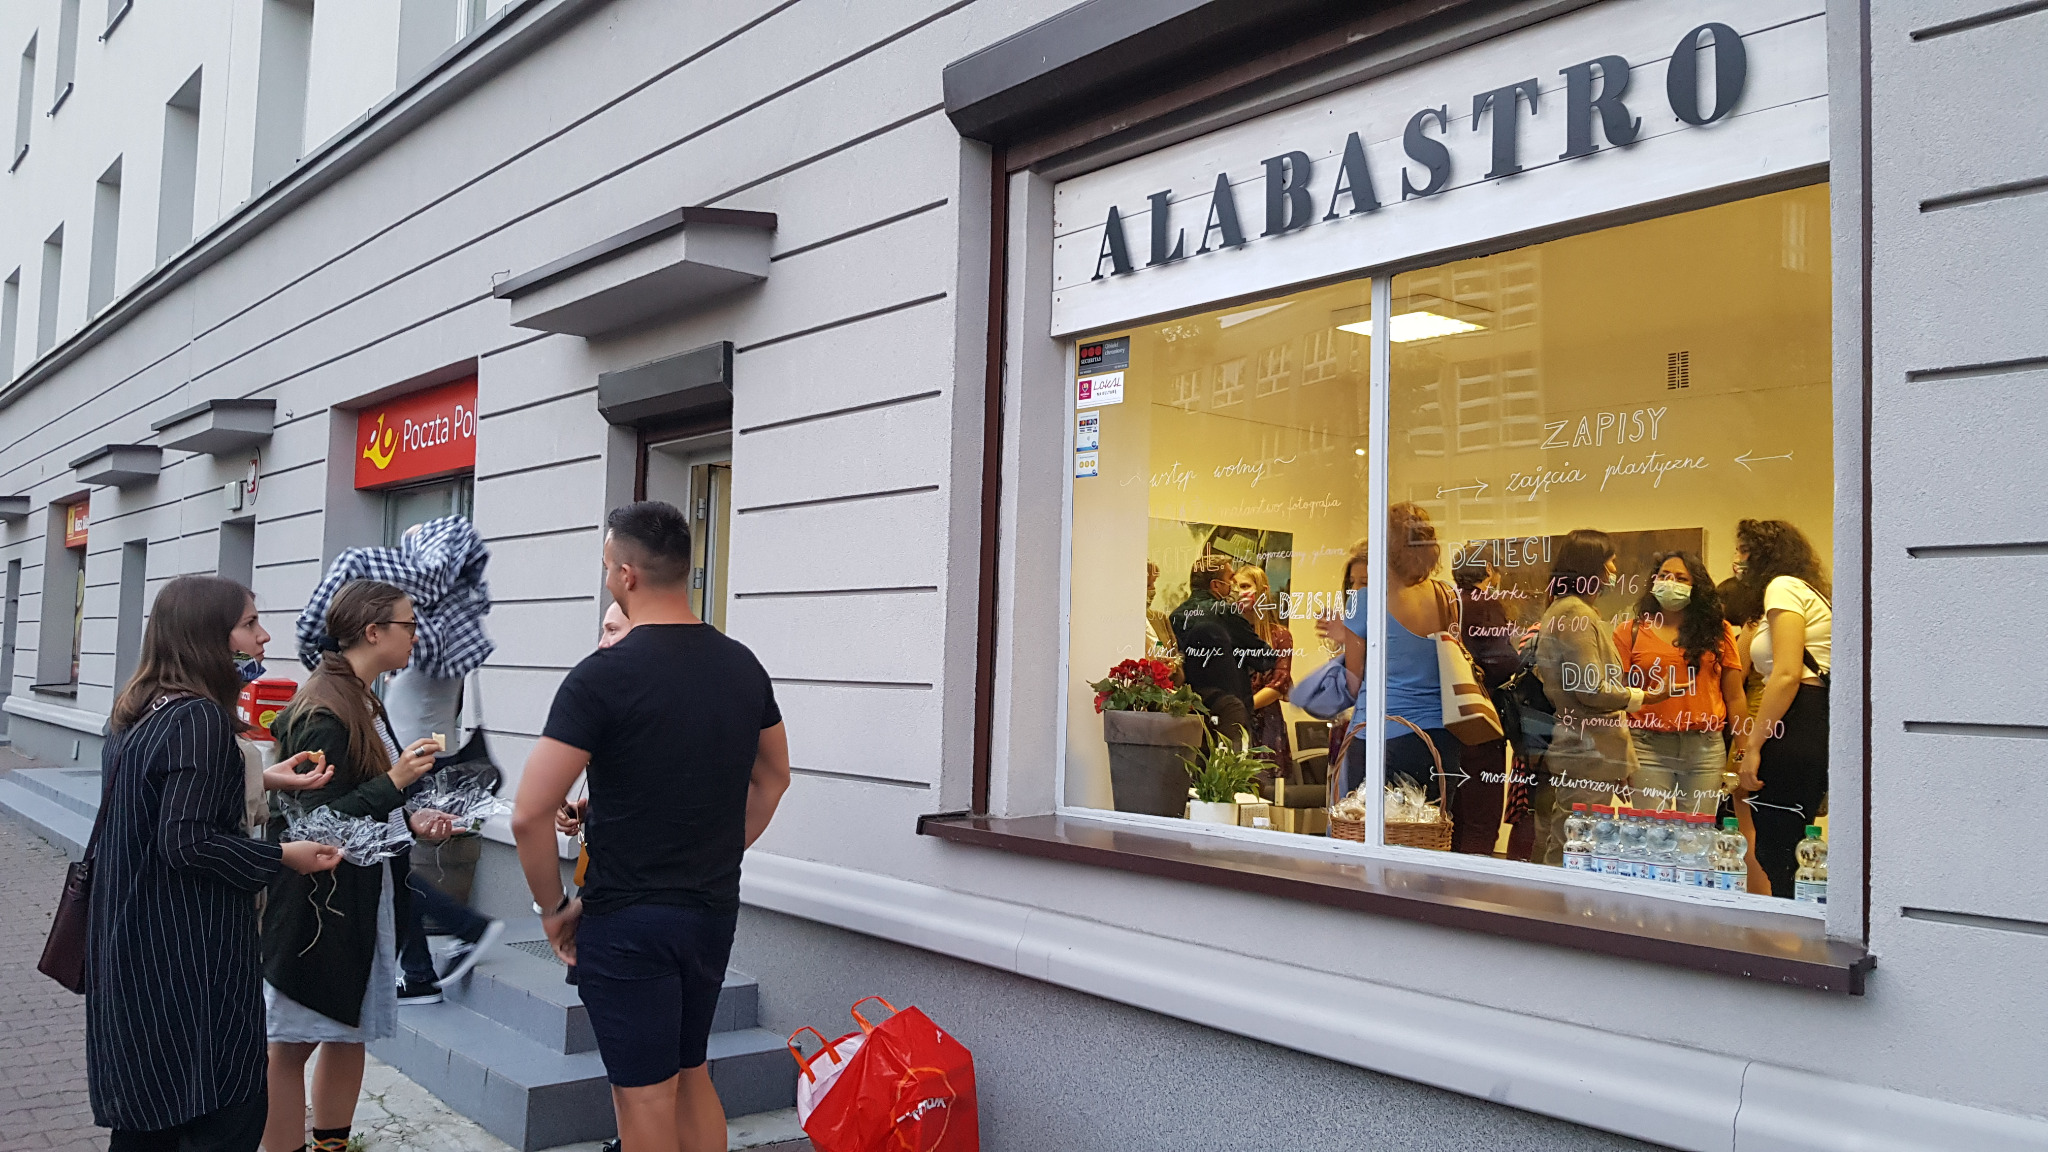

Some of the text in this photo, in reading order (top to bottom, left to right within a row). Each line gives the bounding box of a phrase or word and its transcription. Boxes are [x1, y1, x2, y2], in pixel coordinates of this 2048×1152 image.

[1091, 22, 1747, 282] ALABASTRO
[403, 413, 450, 452] Poczta
[1540, 406, 1668, 450] ZAPISY
[1149, 457, 1265, 492] wstęp wolny
[1505, 450, 1710, 502] zajęcia plastyczne
[1448, 535, 1551, 570] DZIECI
[1279, 588, 1358, 622] DZISIAJ
[1561, 656, 1697, 698] DOROŚLI
